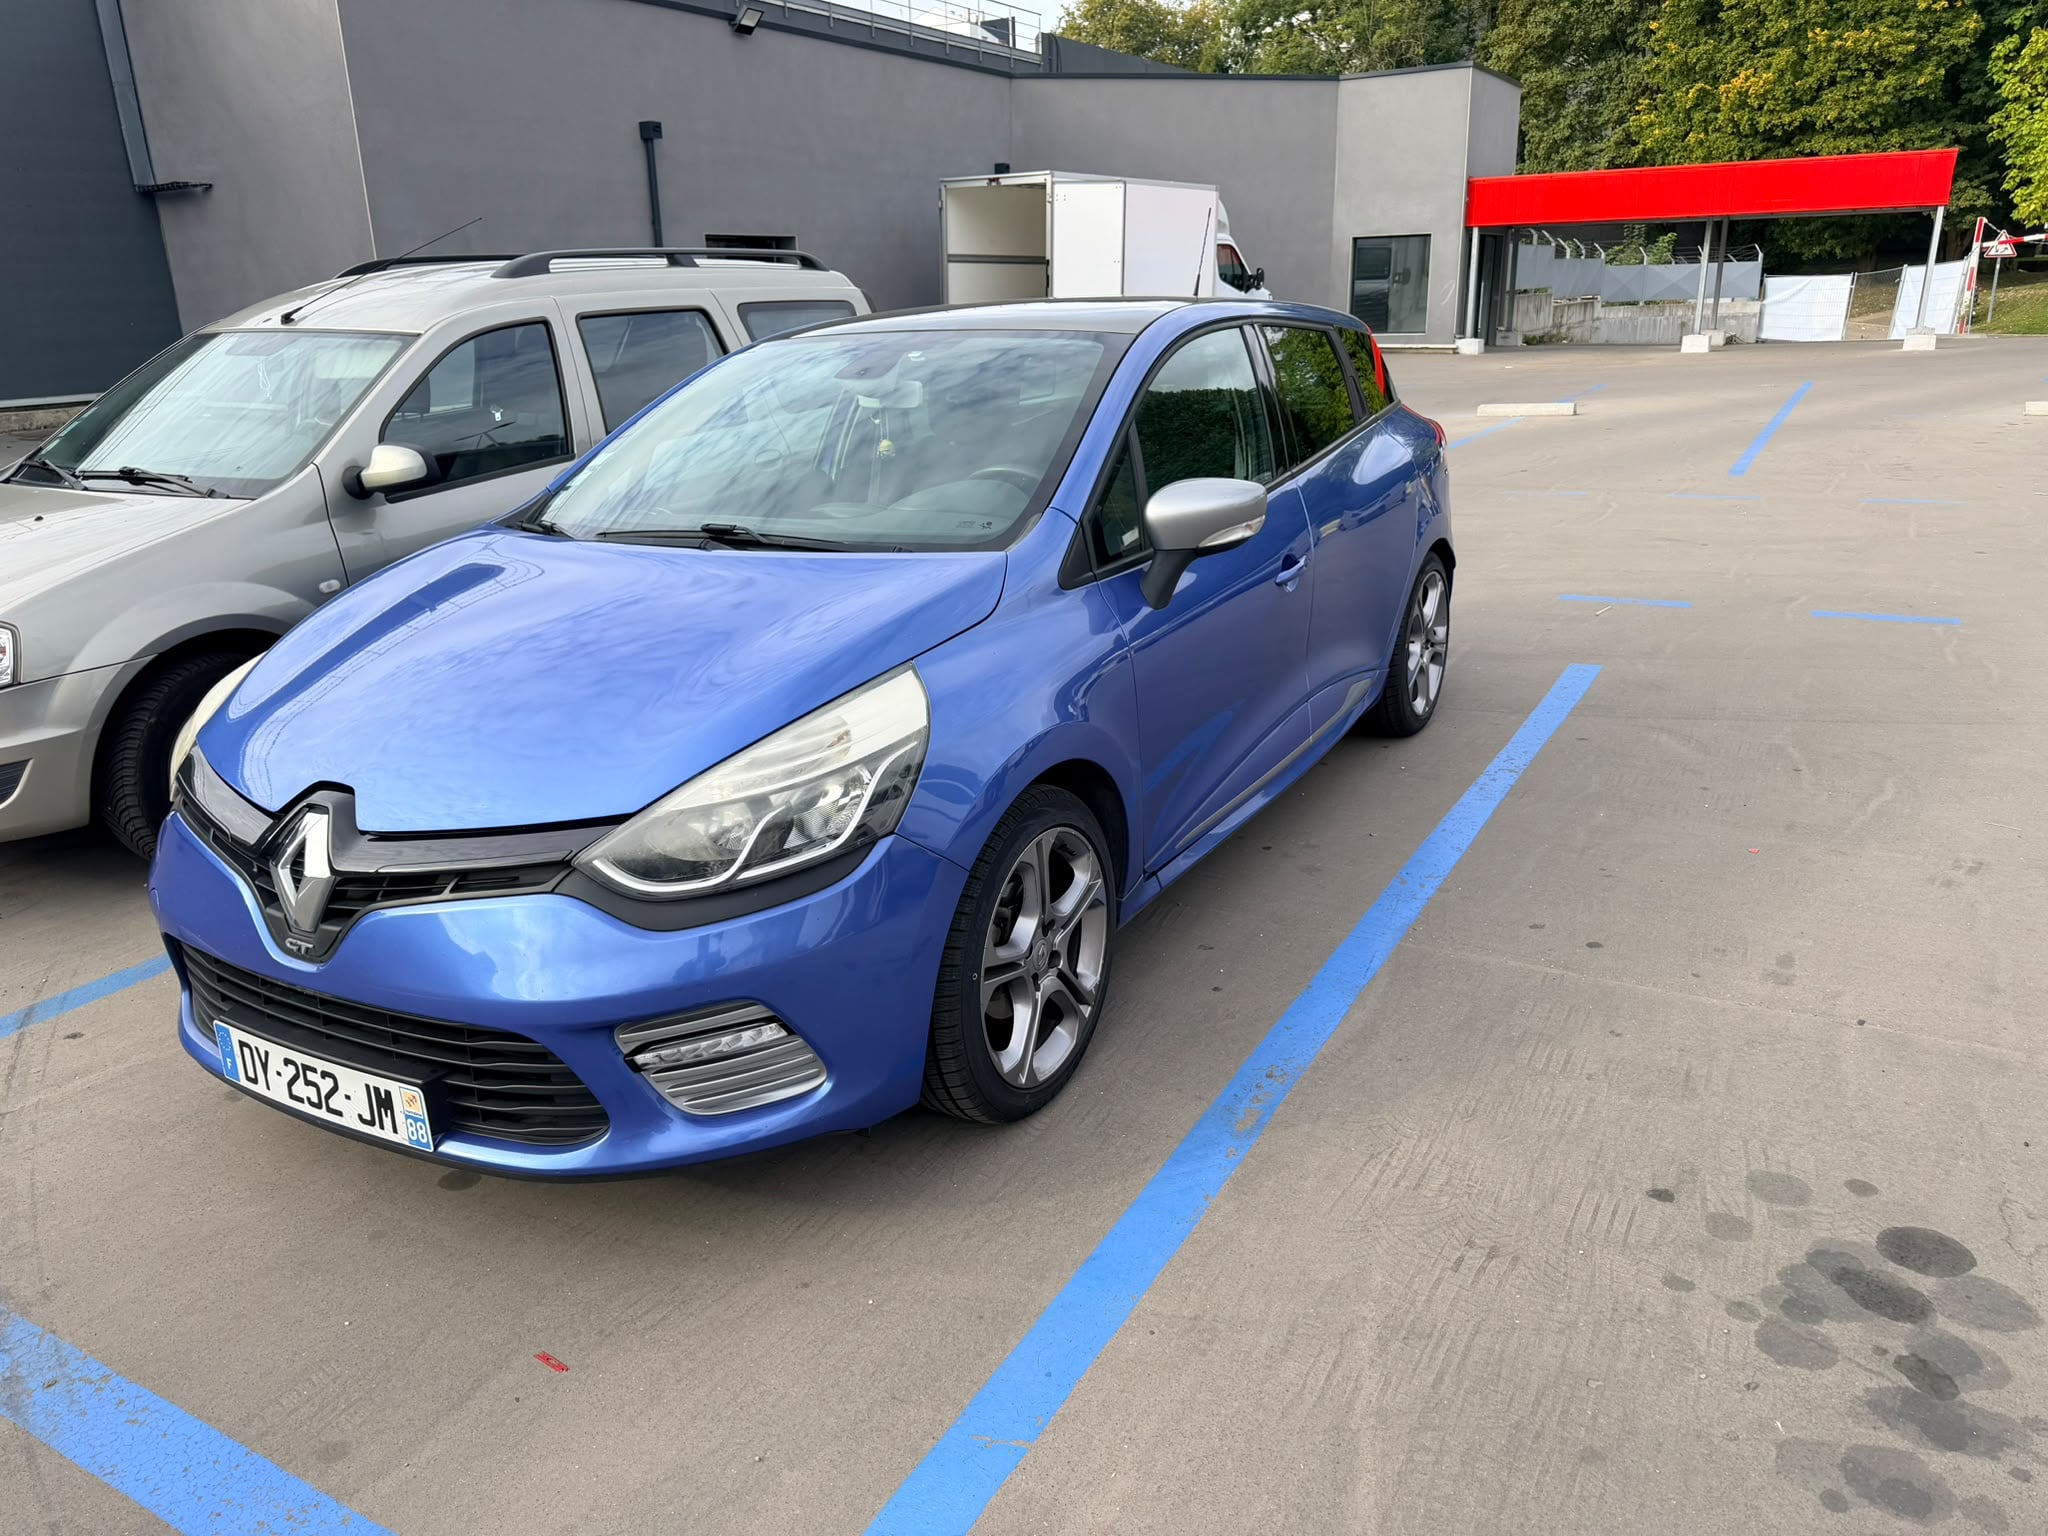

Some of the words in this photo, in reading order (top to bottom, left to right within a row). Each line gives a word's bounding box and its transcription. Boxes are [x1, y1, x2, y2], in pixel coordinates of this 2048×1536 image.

[226, 1058, 233, 1070] F
[238, 1039, 399, 1134] DY-252-JM
[406, 1118, 428, 1143] 88
